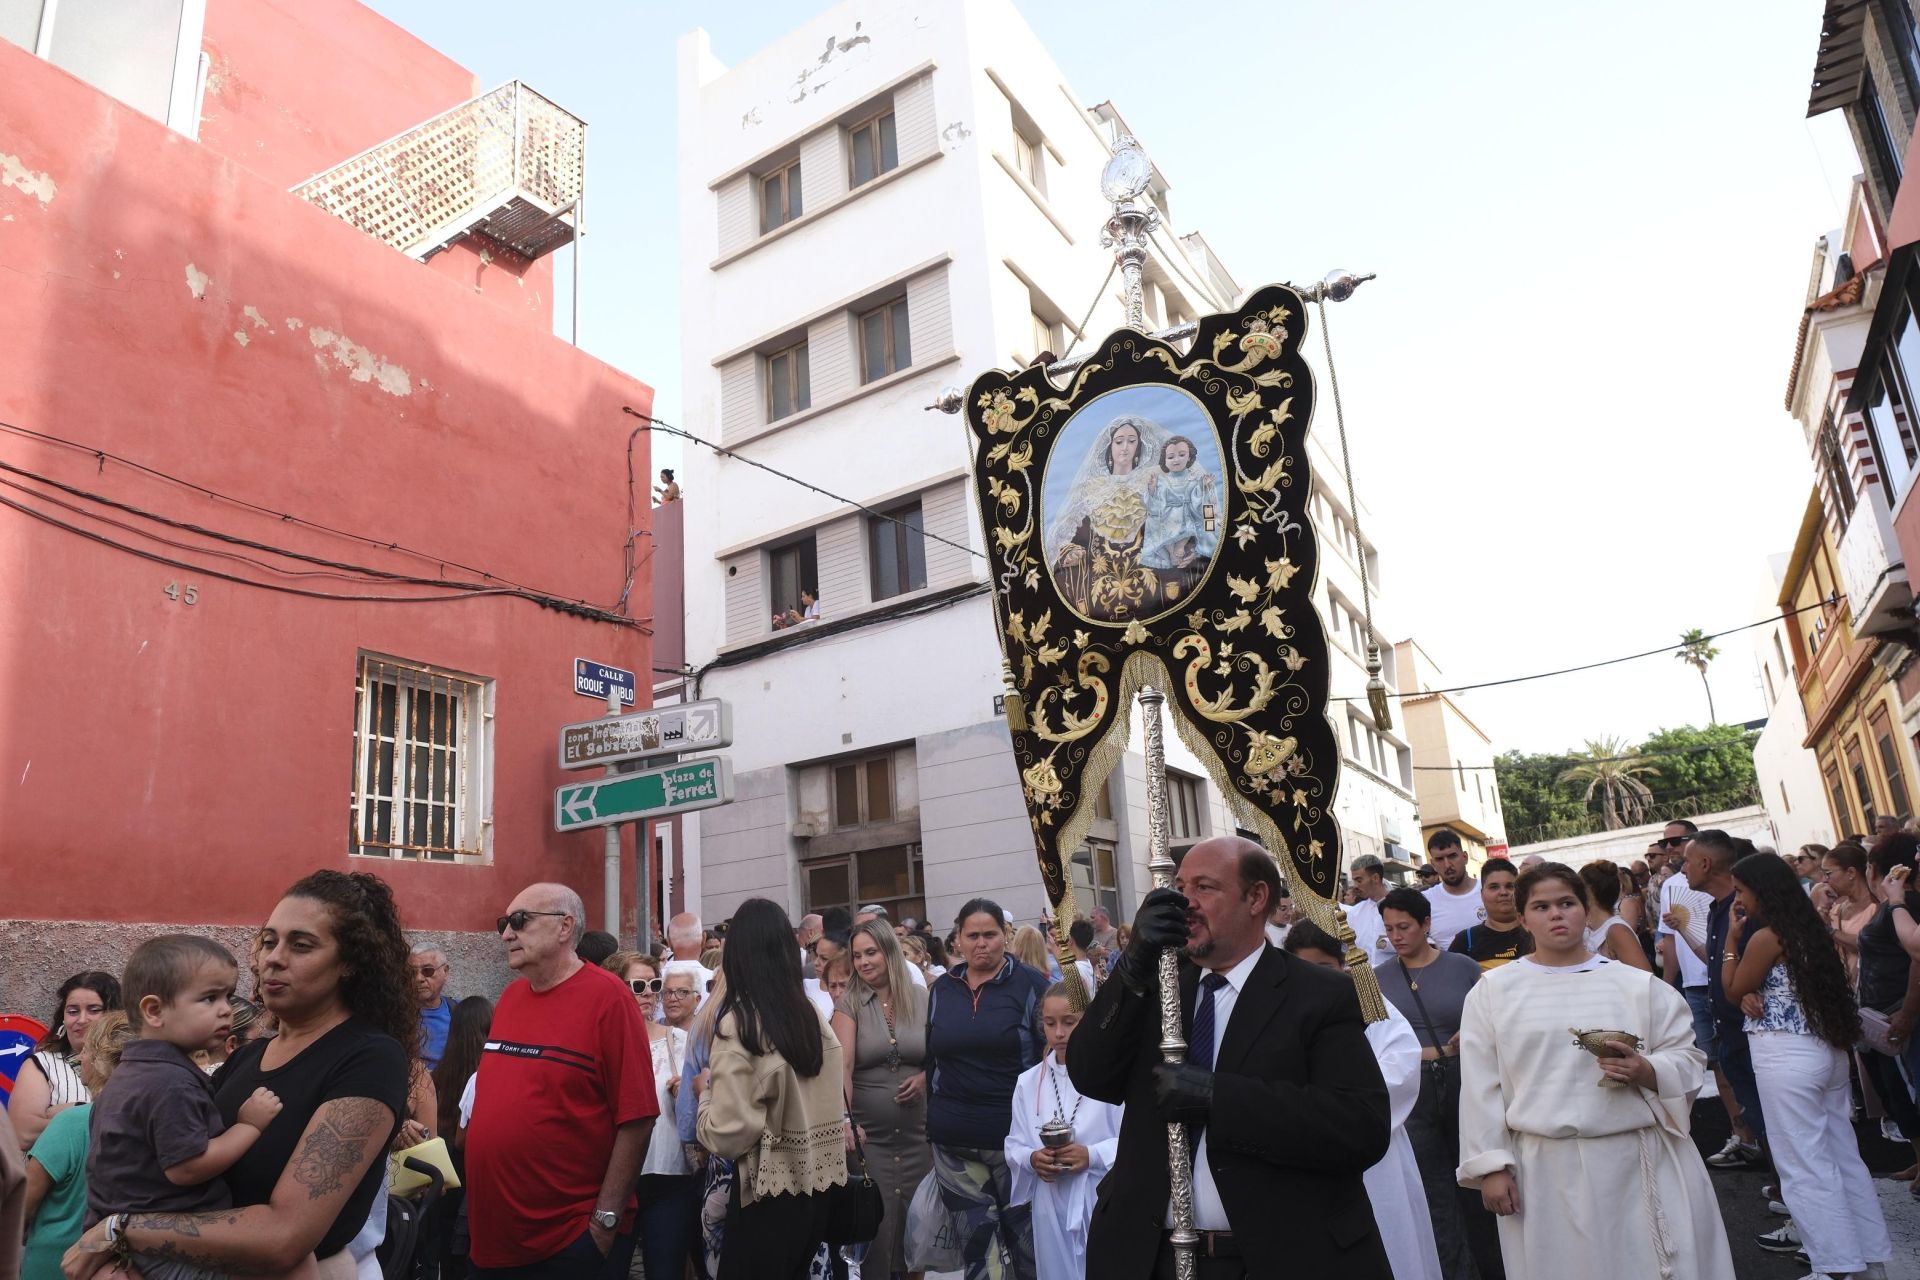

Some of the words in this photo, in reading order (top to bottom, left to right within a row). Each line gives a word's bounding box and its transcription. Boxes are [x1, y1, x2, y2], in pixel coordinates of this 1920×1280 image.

[599, 668, 624, 682] CALLE
[578, 676, 604, 694] ROQUE
[610, 684, 633, 701] NUBLO
[698, 768, 713, 778] de
[667, 779, 714, 801] Ferret
[501, 1044, 520, 1053] TOMMY
